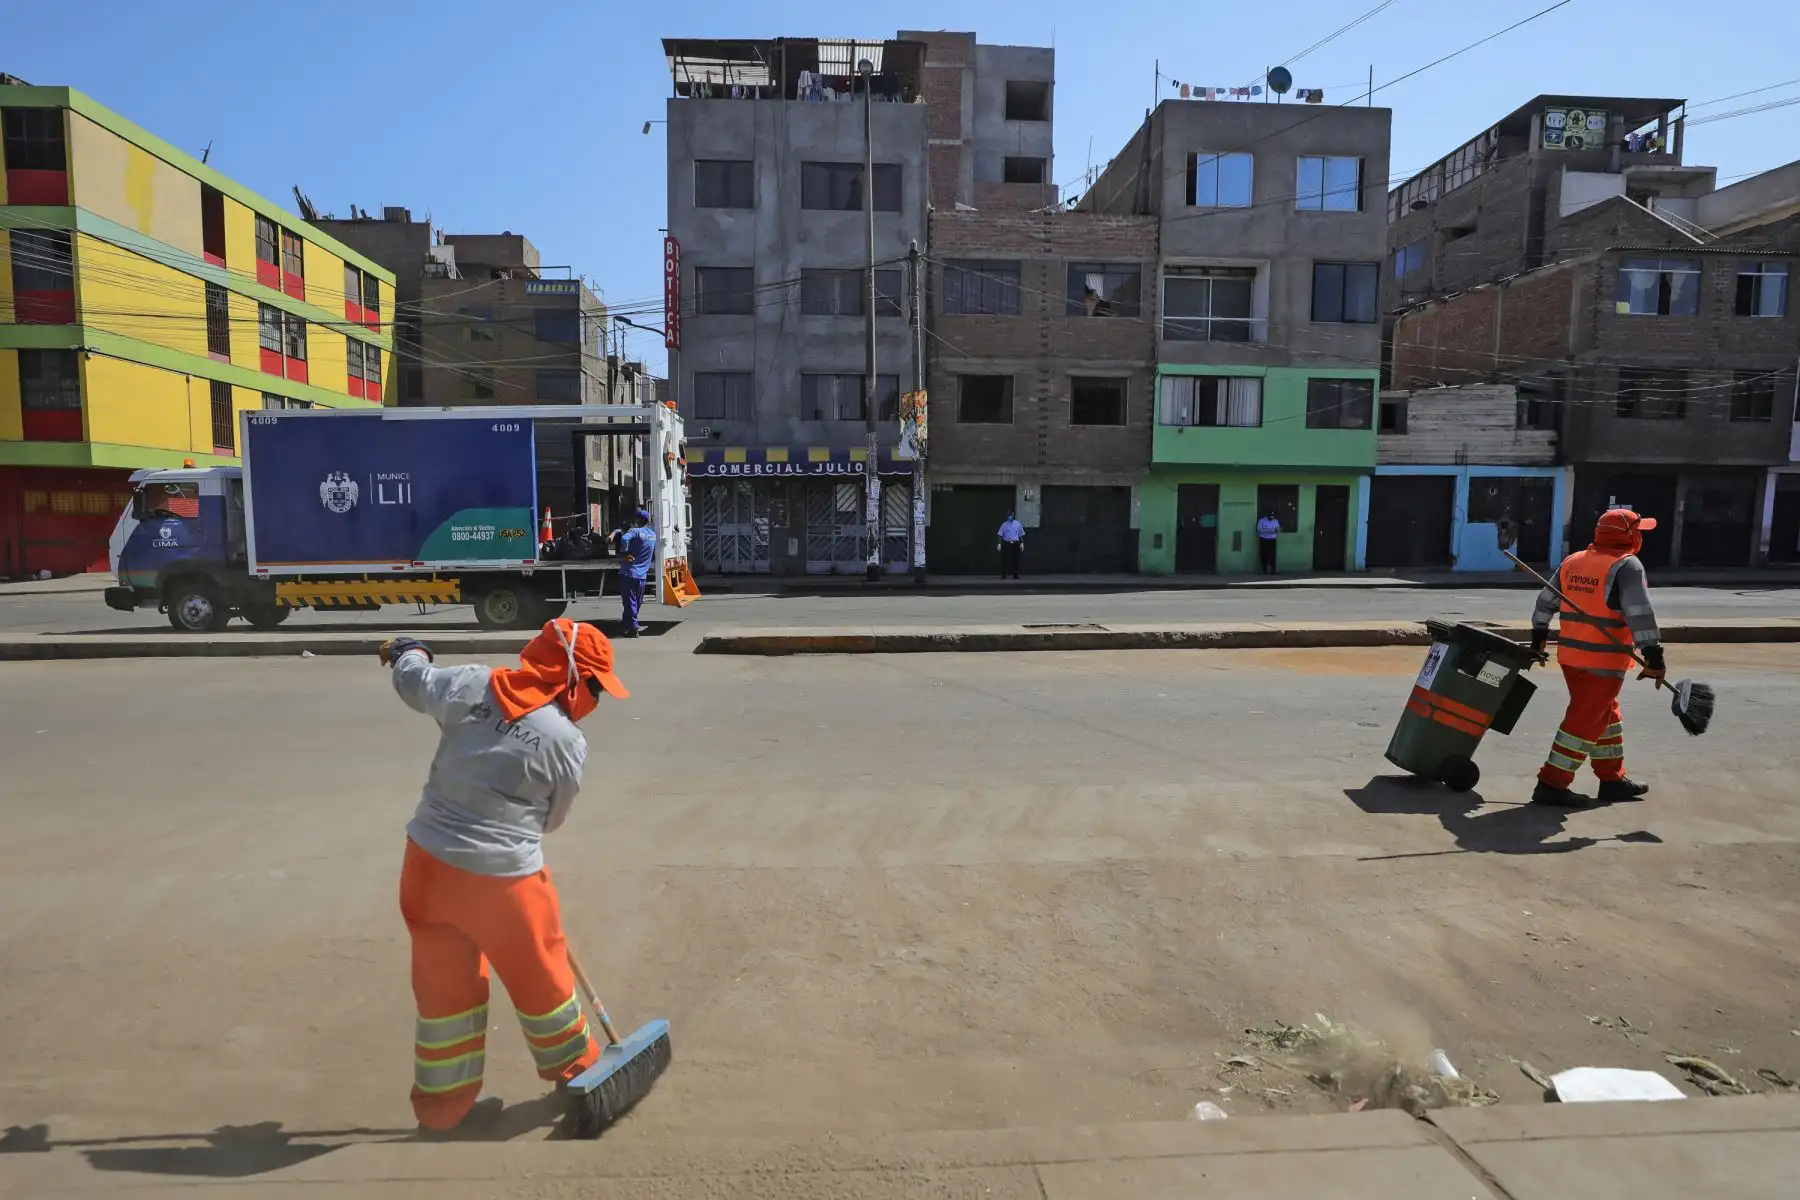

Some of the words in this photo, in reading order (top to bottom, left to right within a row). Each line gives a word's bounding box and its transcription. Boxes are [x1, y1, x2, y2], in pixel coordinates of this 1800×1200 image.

[666, 242, 674, 342] BOTICA
[251, 416, 278, 425] 4009
[492, 423, 520, 432] 4009
[708, 463, 803, 474] COMERCIAL
[816, 462, 864, 473] JULIO
[451, 531, 495, 541] 0800-44937
[495, 720, 540, 751] LIMA
